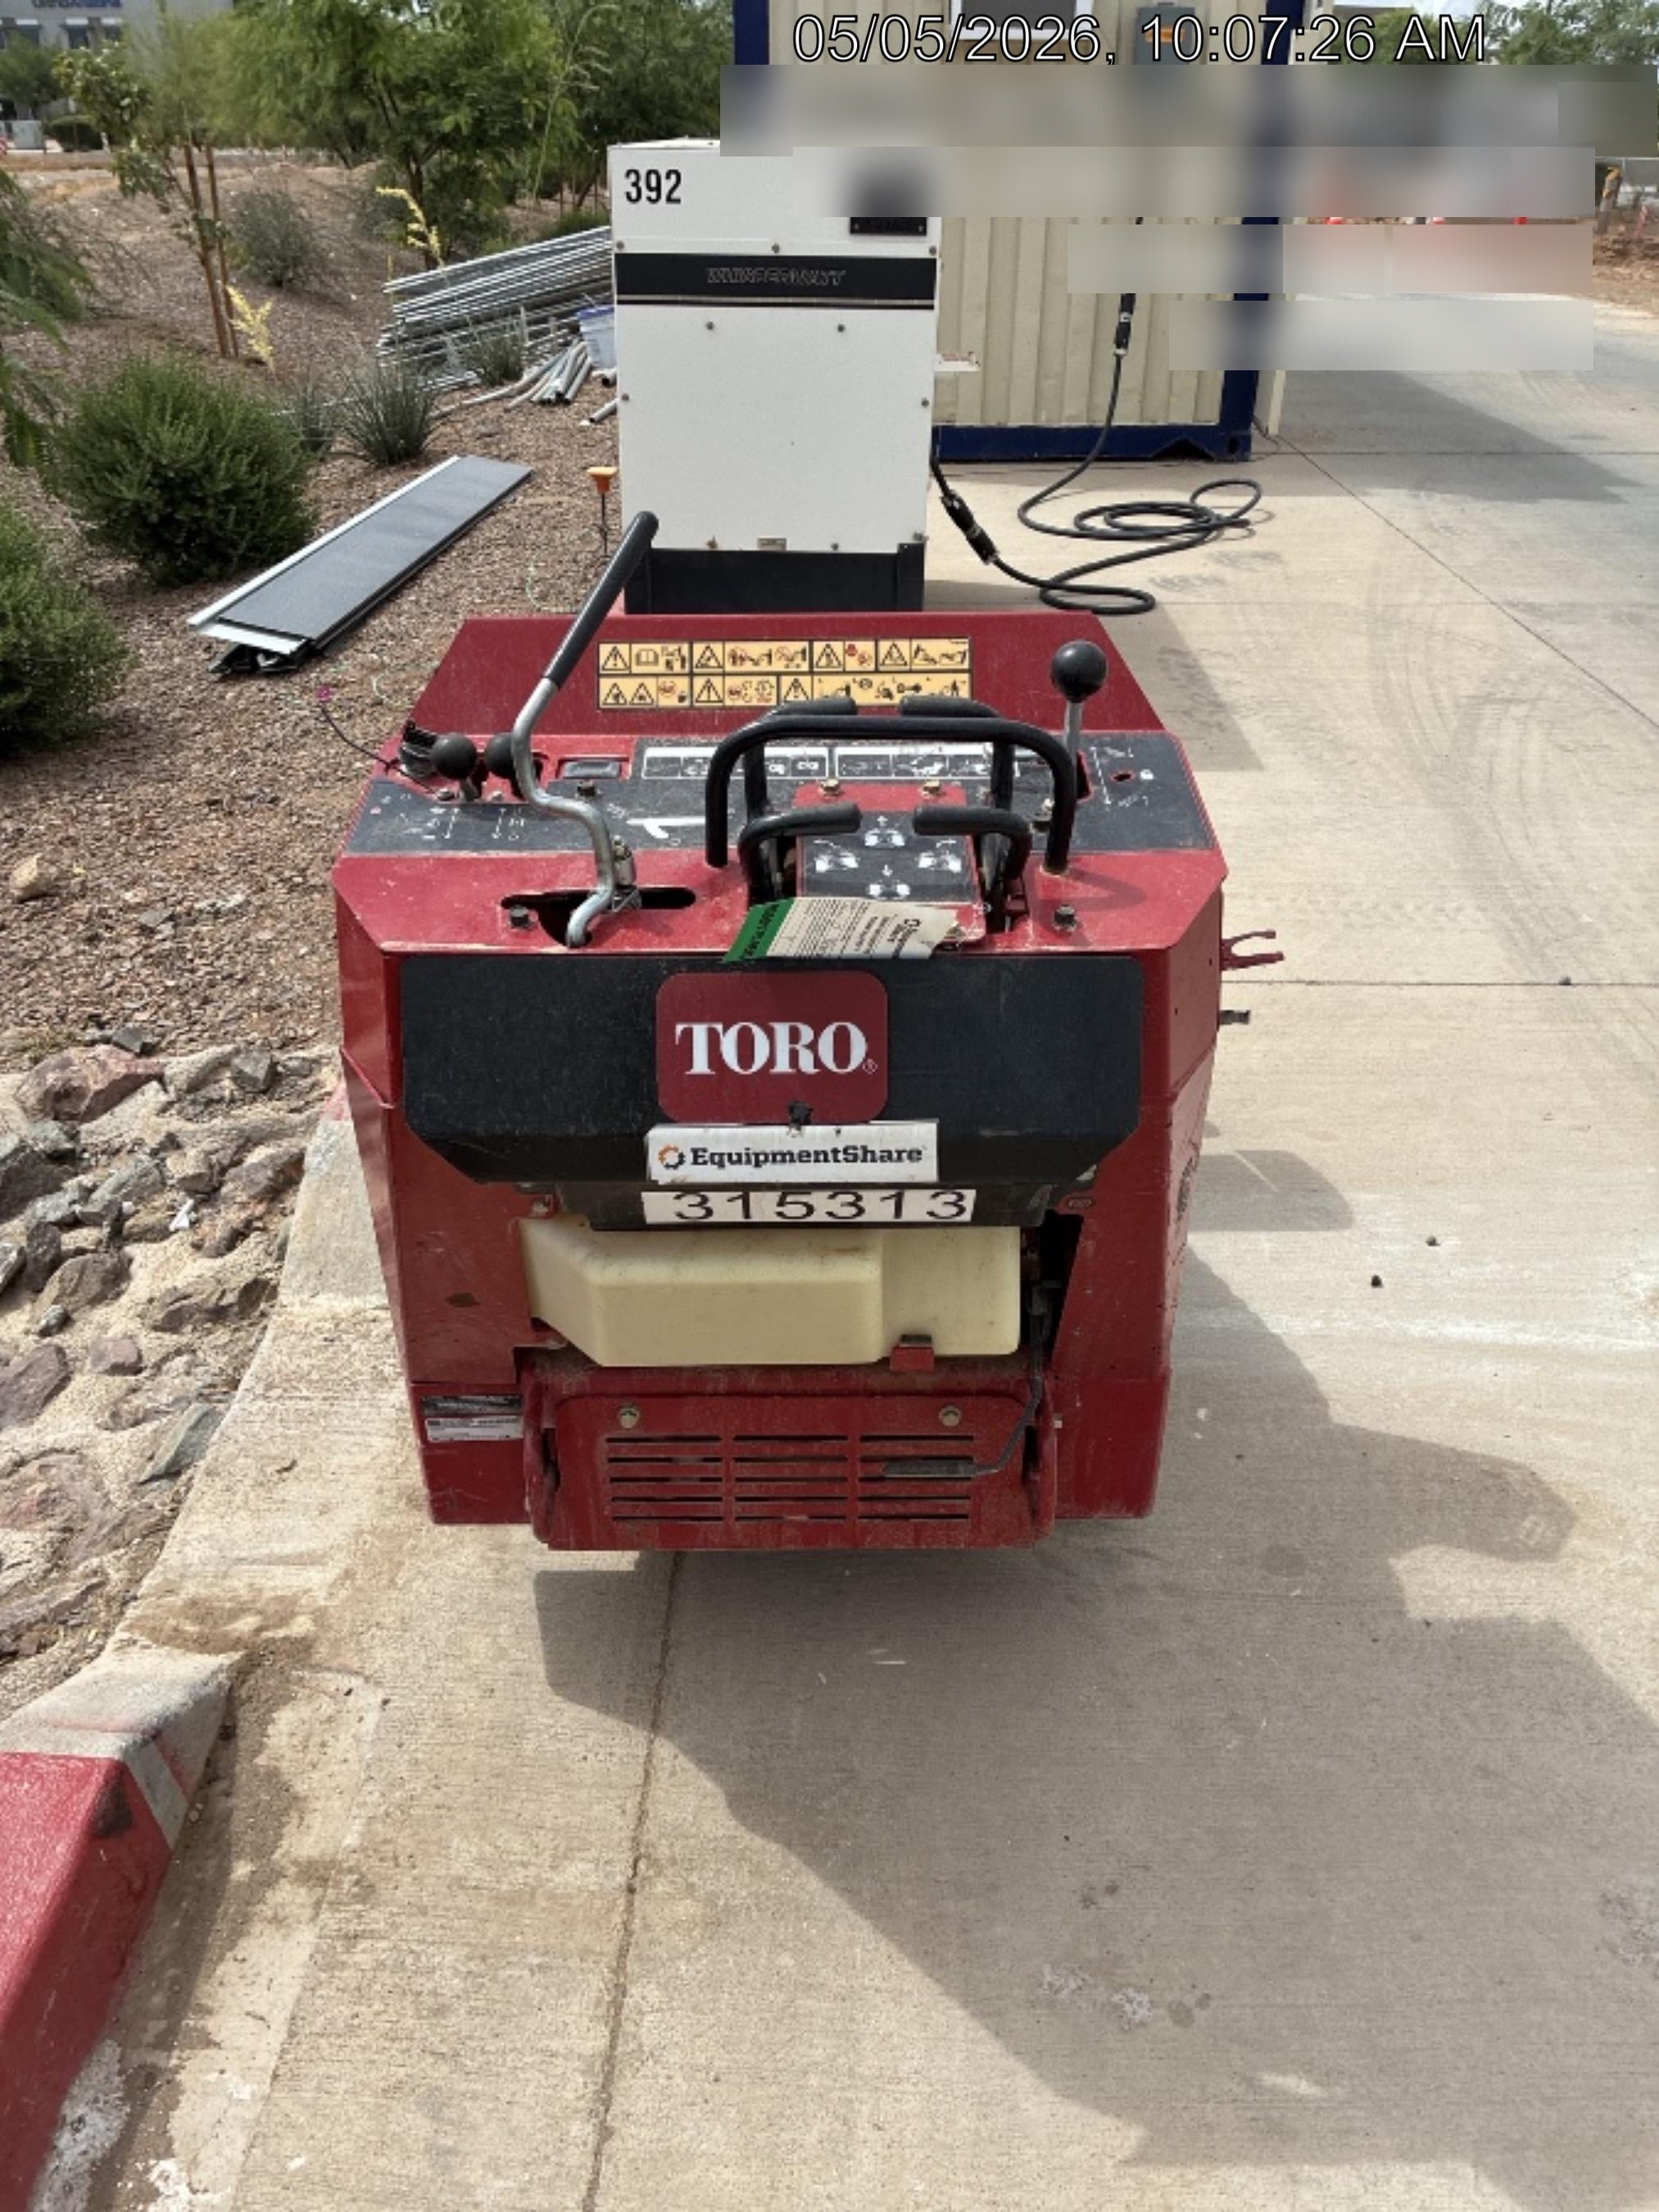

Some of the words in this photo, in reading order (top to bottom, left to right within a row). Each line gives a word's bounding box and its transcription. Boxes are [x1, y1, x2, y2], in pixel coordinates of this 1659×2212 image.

[625, 169, 682, 204] 392
[691, 1145, 922, 1169] EquipmentShare
[672, 1190, 968, 1221] 315313
